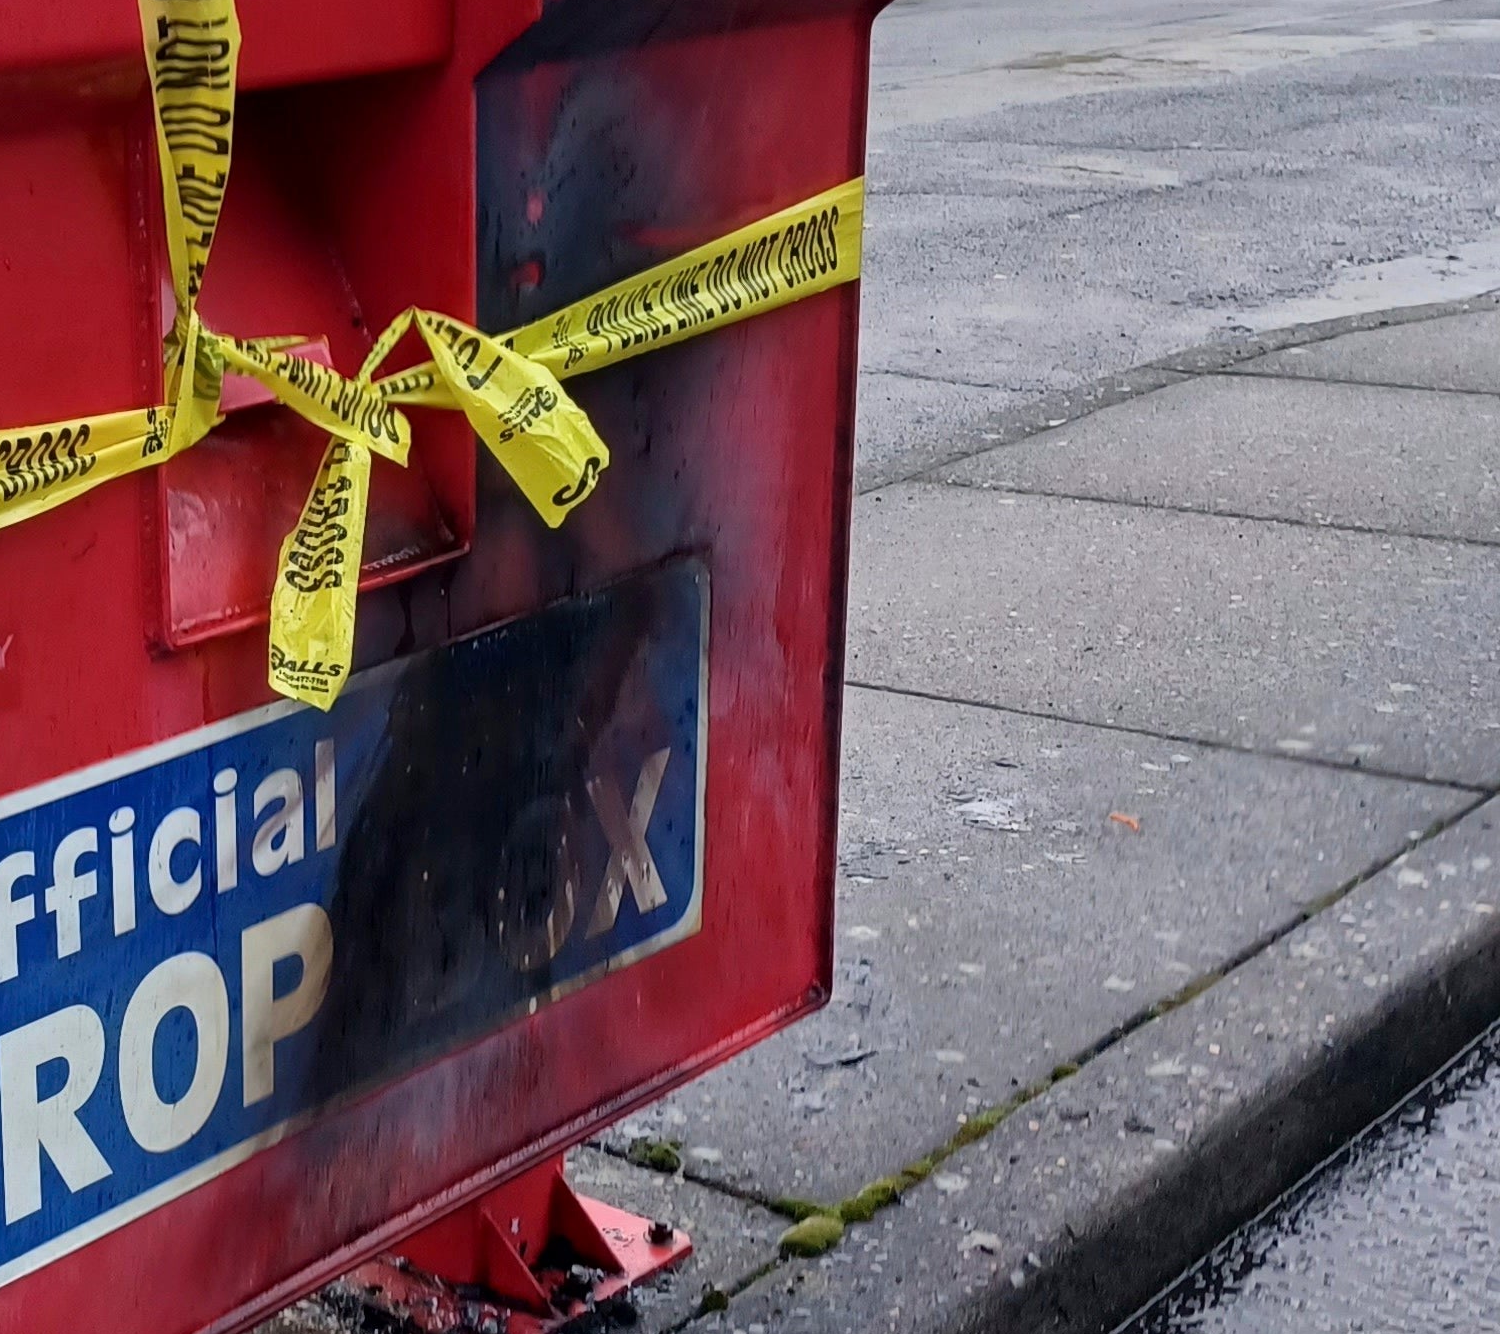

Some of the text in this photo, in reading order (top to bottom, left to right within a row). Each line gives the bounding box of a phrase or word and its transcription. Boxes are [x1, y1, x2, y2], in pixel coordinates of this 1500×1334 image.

[156, 13, 231, 93] NOT
[587, 282, 671, 354] POLICE
[659, 260, 715, 330] LINE
[706, 248, 743, 315] DO
[737, 231, 781, 304] NOT
[777, 205, 840, 289] CROSS
[270, 643, 345, 678] GALLS
